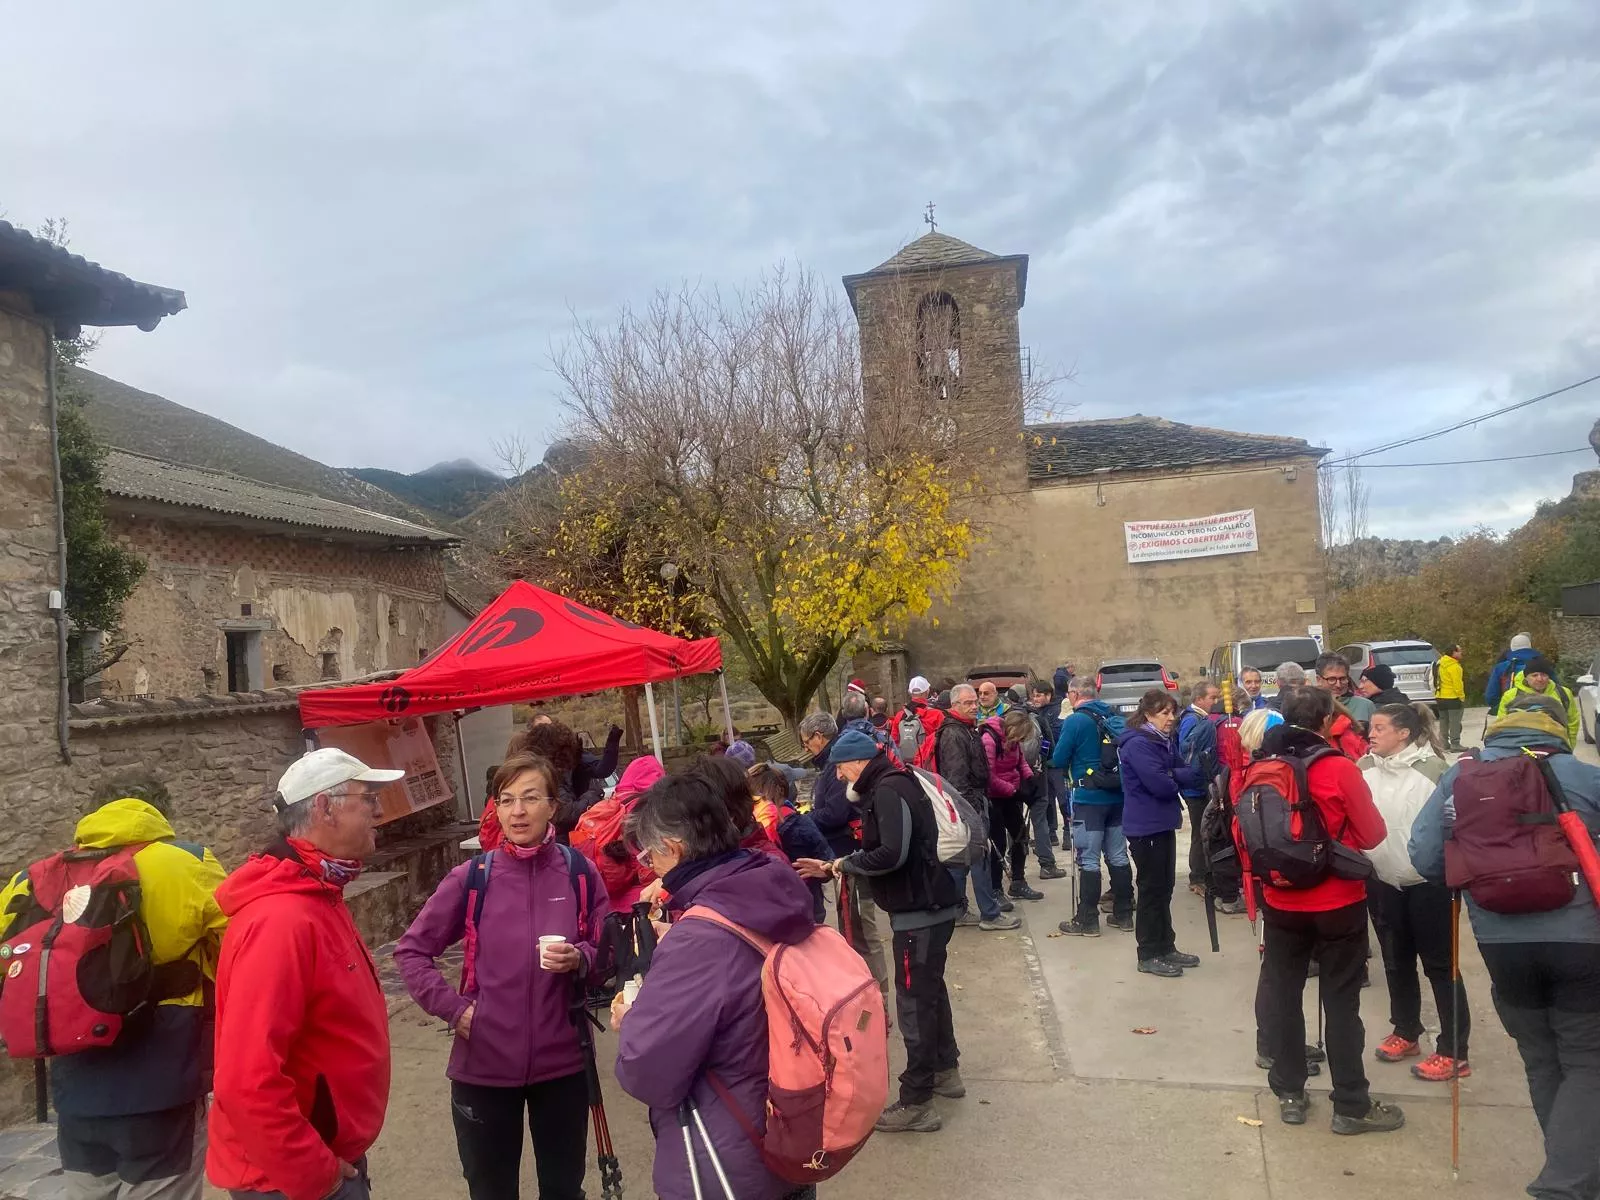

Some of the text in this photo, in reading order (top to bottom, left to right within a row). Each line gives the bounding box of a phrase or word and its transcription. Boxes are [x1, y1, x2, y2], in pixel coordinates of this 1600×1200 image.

[1187, 527, 1206, 535] PERO
[1219, 522, 1250, 531] CALLADO
[1182, 533, 1230, 544] COBERTURA
